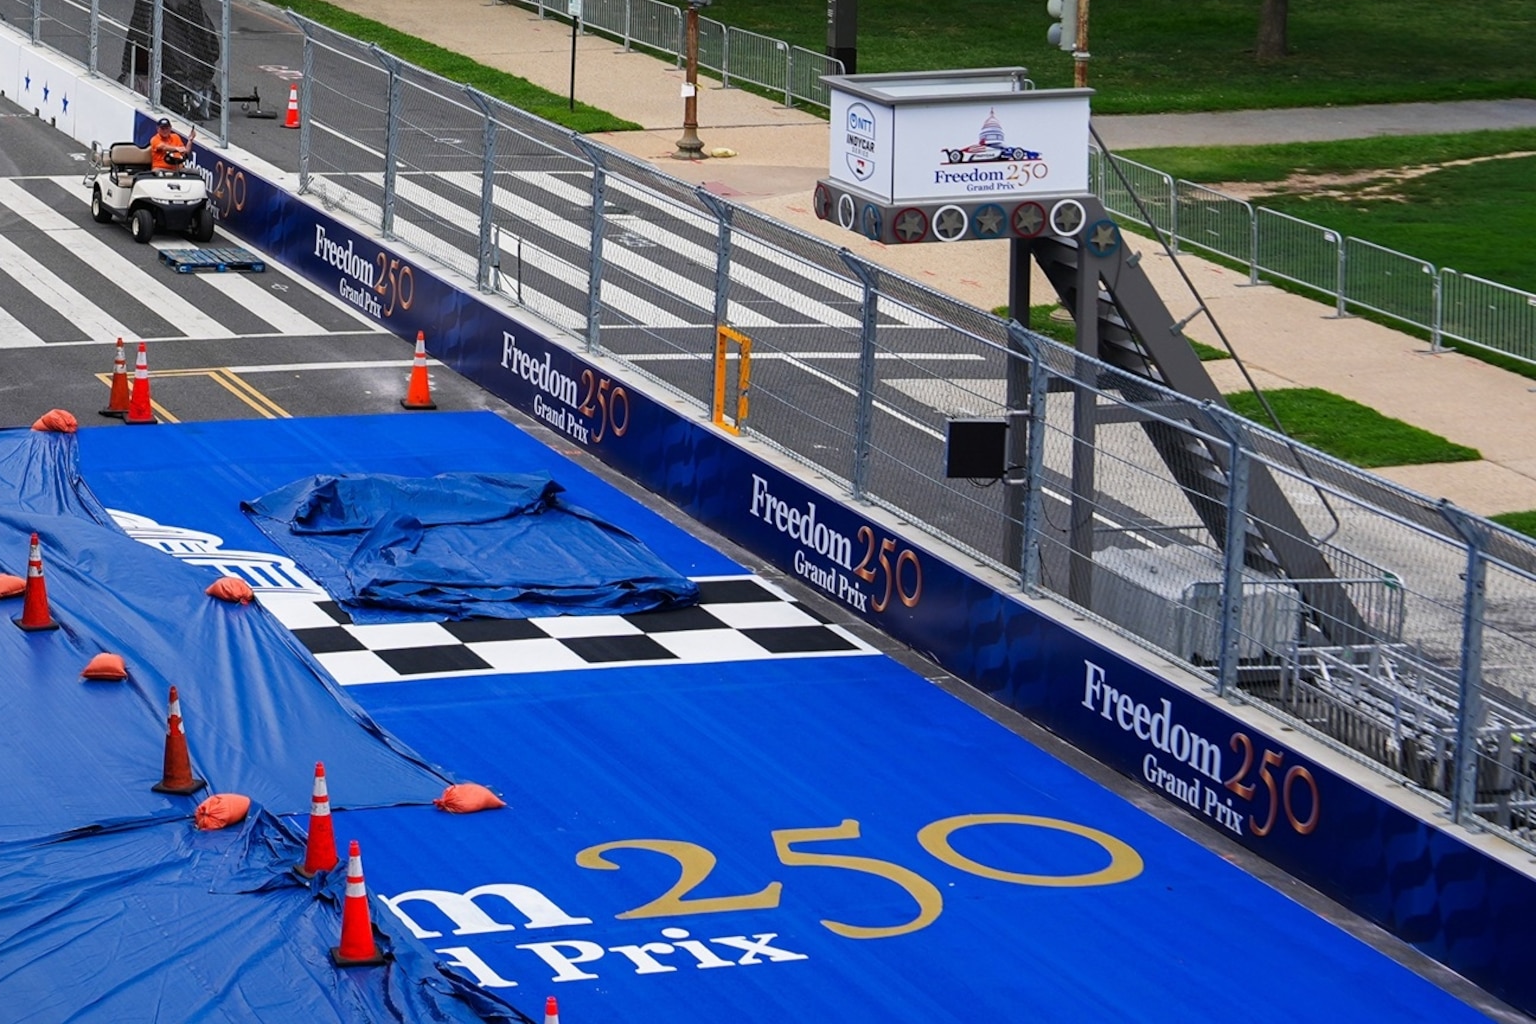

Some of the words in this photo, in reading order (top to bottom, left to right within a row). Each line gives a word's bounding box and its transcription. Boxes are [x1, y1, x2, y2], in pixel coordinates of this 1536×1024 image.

[846, 133, 876, 154] INDYCAR
[858, 116, 873, 133] NTT
[214, 160, 247, 218] 250
[934, 168, 1004, 184] Freedom
[1006, 162, 1049, 187] 250
[966, 182, 995, 192] Grand
[997, 181, 1016, 191] Prix
[314, 223, 374, 289] Freedom
[373, 251, 414, 317] 250
[339, 277, 365, 308] Grand
[364, 291, 383, 319] Prix
[500, 330, 578, 410] Freedom
[578, 368, 629, 444] 250
[533, 393, 566, 431] Grand
[566, 412, 589, 445] Prix
[749, 473, 853, 572] Freedom
[852, 525, 923, 614] 250
[793, 549, 837, 595] Grand
[837, 573, 867, 614] Prix
[1081, 659, 1223, 785] Freedom
[1223, 731, 1321, 838] 250
[1142, 752, 1200, 812] Grand
[1203, 785, 1244, 837] Prix
[575, 813, 1145, 939] 250
[515, 928, 809, 983] Prix
